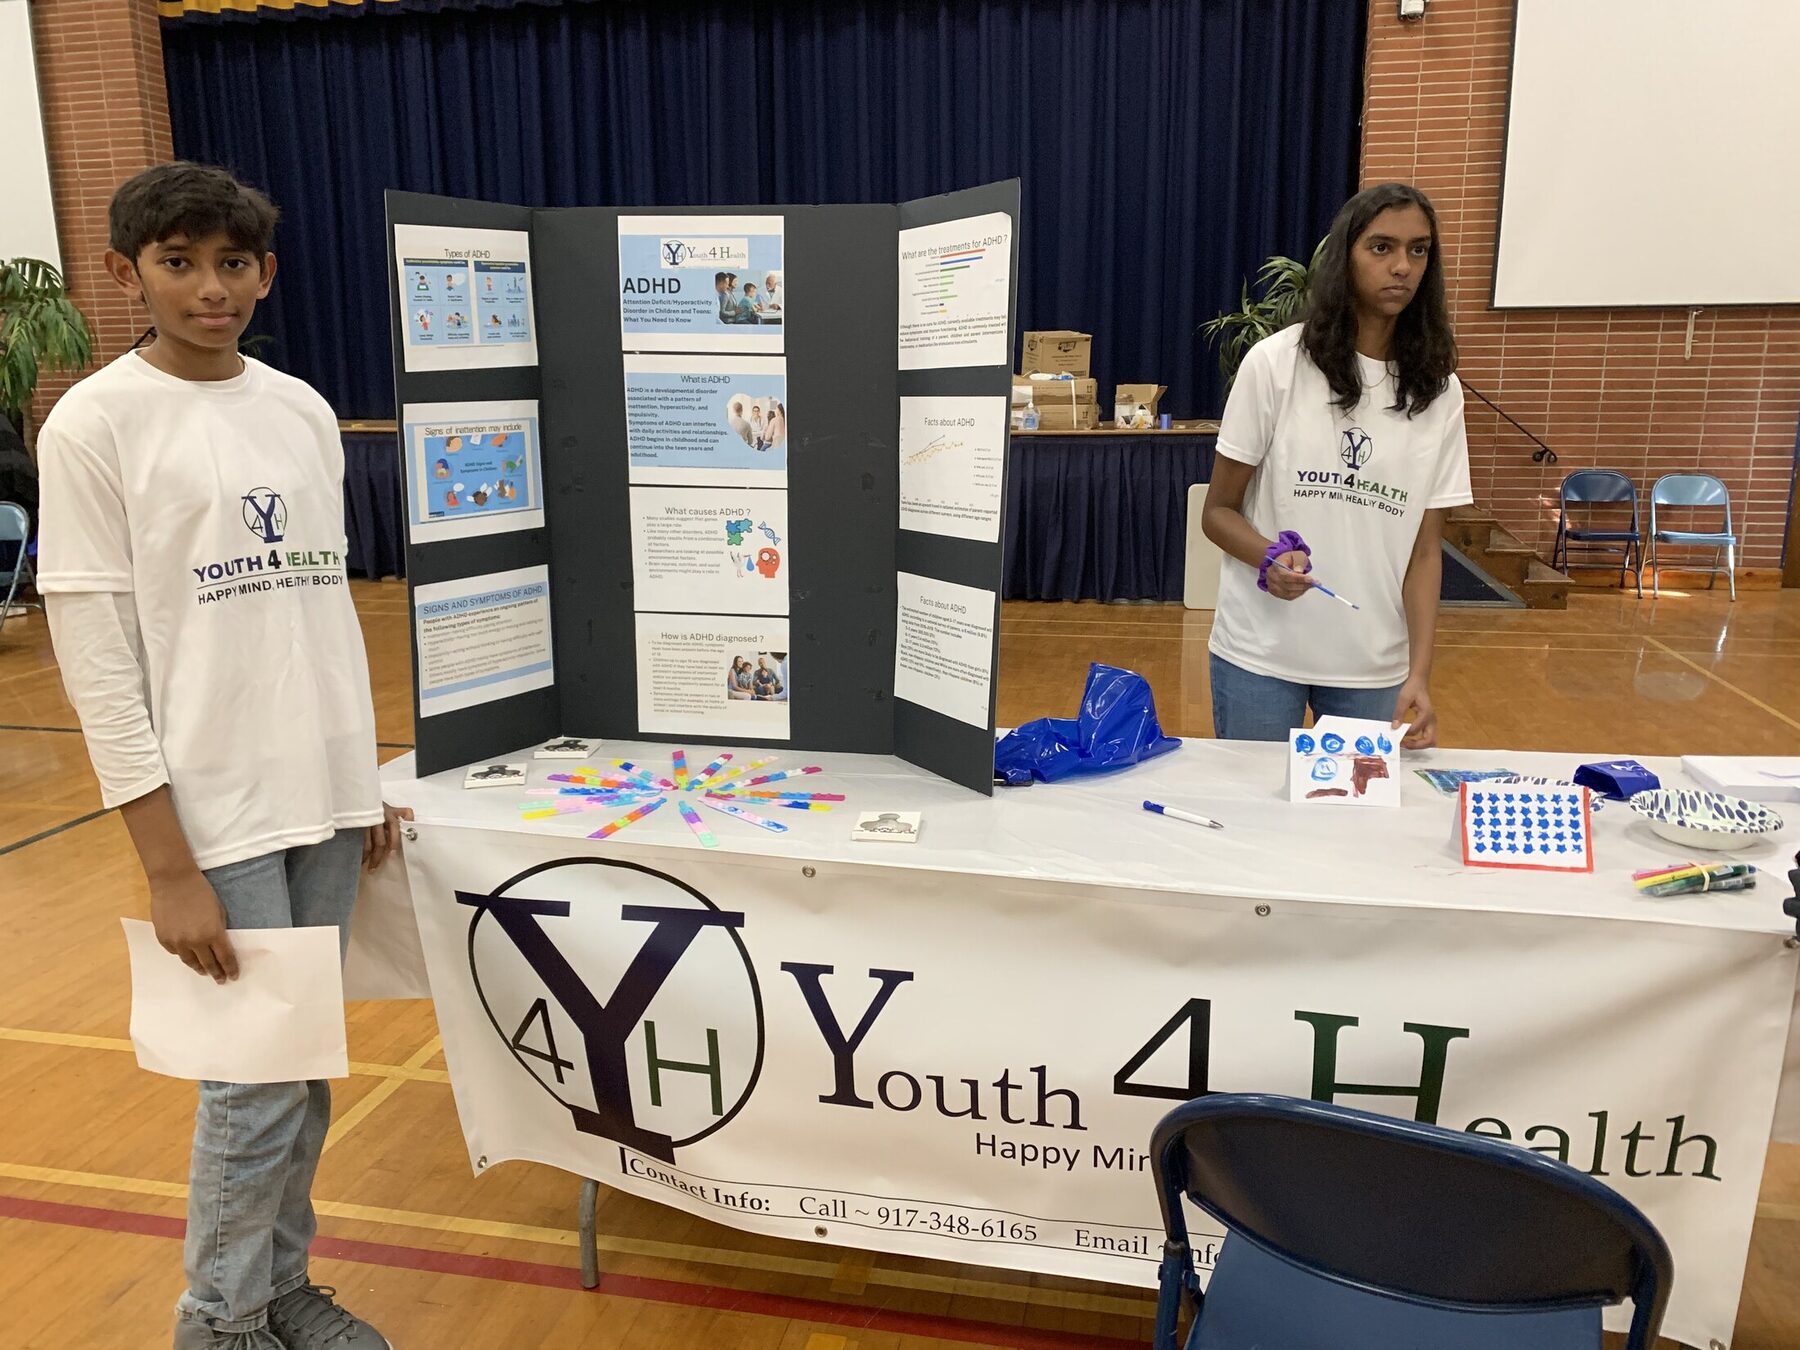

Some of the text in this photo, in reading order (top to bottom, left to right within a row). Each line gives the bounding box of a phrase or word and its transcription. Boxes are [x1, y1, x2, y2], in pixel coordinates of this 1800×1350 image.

[444, 249, 491, 259] Types of ADHD
[687, 247, 746, 258] Youth 4 Health
[902, 251, 917, 260] What
[928, 248, 937, 256] the
[939, 243, 971, 254] treatments
[972, 240, 981, 248] for
[982, 235, 1002, 247] ADHD
[623, 278, 681, 294] ADHD
[681, 375, 730, 384] What is ADHD
[425, 427, 444, 436] Signs
[446, 427, 453, 435] of
[455, 426, 486, 434] inattention
[489, 425, 501, 433] may
[925, 418, 939, 426] Facts
[957, 418, 975, 427] ADHD
[1342, 431, 1371, 471] Y
[1344, 473, 1355, 488] 4
[665, 507, 687, 515] What
[719, 508, 744, 516] ADHD
[1293, 489, 1326, 498] HAPPY
[1378, 502, 1405, 518] BODY
[241, 494, 283, 543] Y
[193, 556, 263, 582] YOUTH
[267, 550, 282, 570] 4
[198, 586, 237, 605] HAPPY
[312, 575, 343, 585] BODY
[423, 586, 543, 615] SIGNS AND SYMPTOMS OF ADHD
[920, 595, 967, 614] Facts about ADHD
[433, 623, 456, 631] following
[476, 615, 500, 624] symptoms:
[661, 632, 680, 640] How
[689, 633, 714, 641] ADHD
[716, 634, 757, 643] diagnosed
[454, 890, 745, 1165] 4 Y H
[780, 961, 1088, 1131] Youth
[1114, 998, 1230, 1101] 4
[975, 1132, 1080, 1171] Happy
[629, 1158, 707, 1200] Contact
[714, 1188, 771, 1212] Info:
[800, 1196, 847, 1219] Call
[878, 1207, 1038, 1242] 917-348-6165
[1075, 1229, 1149, 1255] Email
